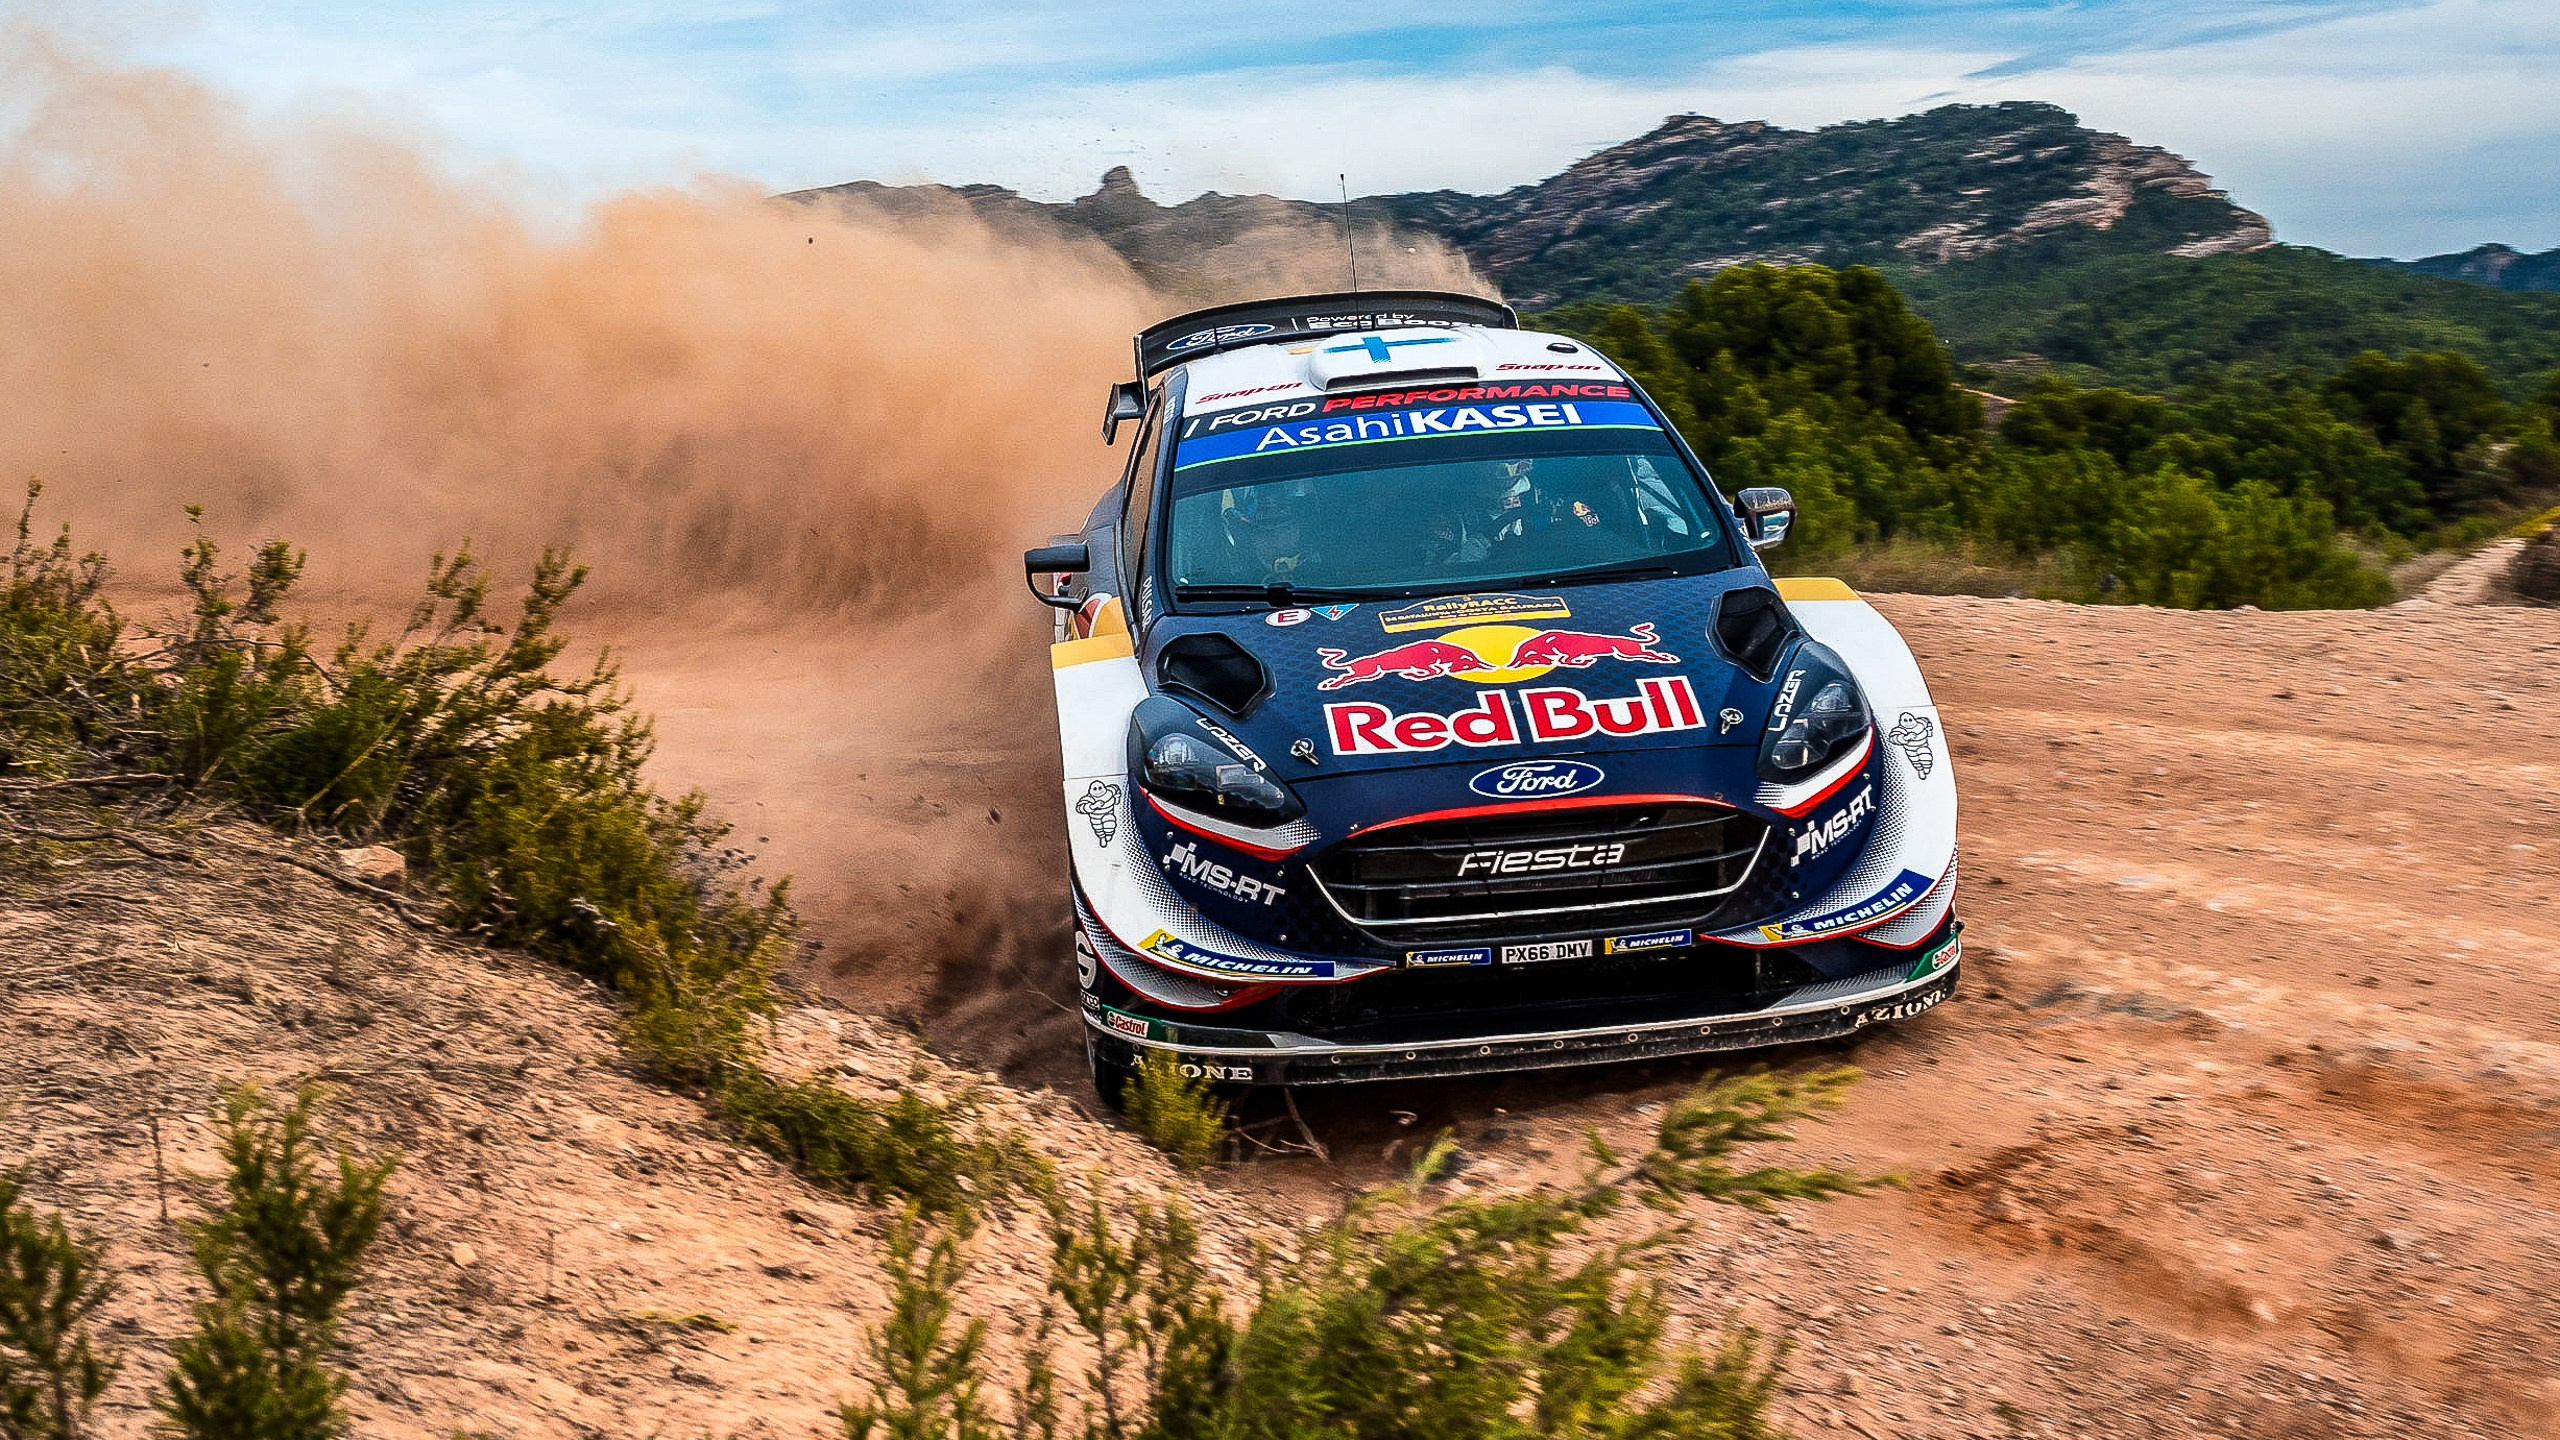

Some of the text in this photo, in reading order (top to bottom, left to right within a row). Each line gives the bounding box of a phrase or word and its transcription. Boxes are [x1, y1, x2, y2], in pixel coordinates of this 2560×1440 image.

[1186, 327, 1256, 347] Ford
[1495, 363, 1602, 371] Snap-on
[1208, 403, 1316, 430] FORD
[1321, 384, 1630, 413] PERFORMANCE
[1422, 598, 1518, 612] RallyRACC
[1278, 611, 1299, 623] E
[1325, 677, 1705, 754] Red Bull
[1496, 765, 1578, 793] Ford
[1457, 843, 1625, 877] Fiesta
[1813, 883, 1914, 930] MICHELIN
[1506, 942, 1588, 962] PX66 DMV
[1629, 935, 1684, 948] MICHELIN
[1184, 953, 1313, 974] MICHELIN
[1427, 953, 1483, 963] MICHELIN
[1855, 988, 1947, 1028] AZION
[1115, 1015, 1147, 1036] Castrol
